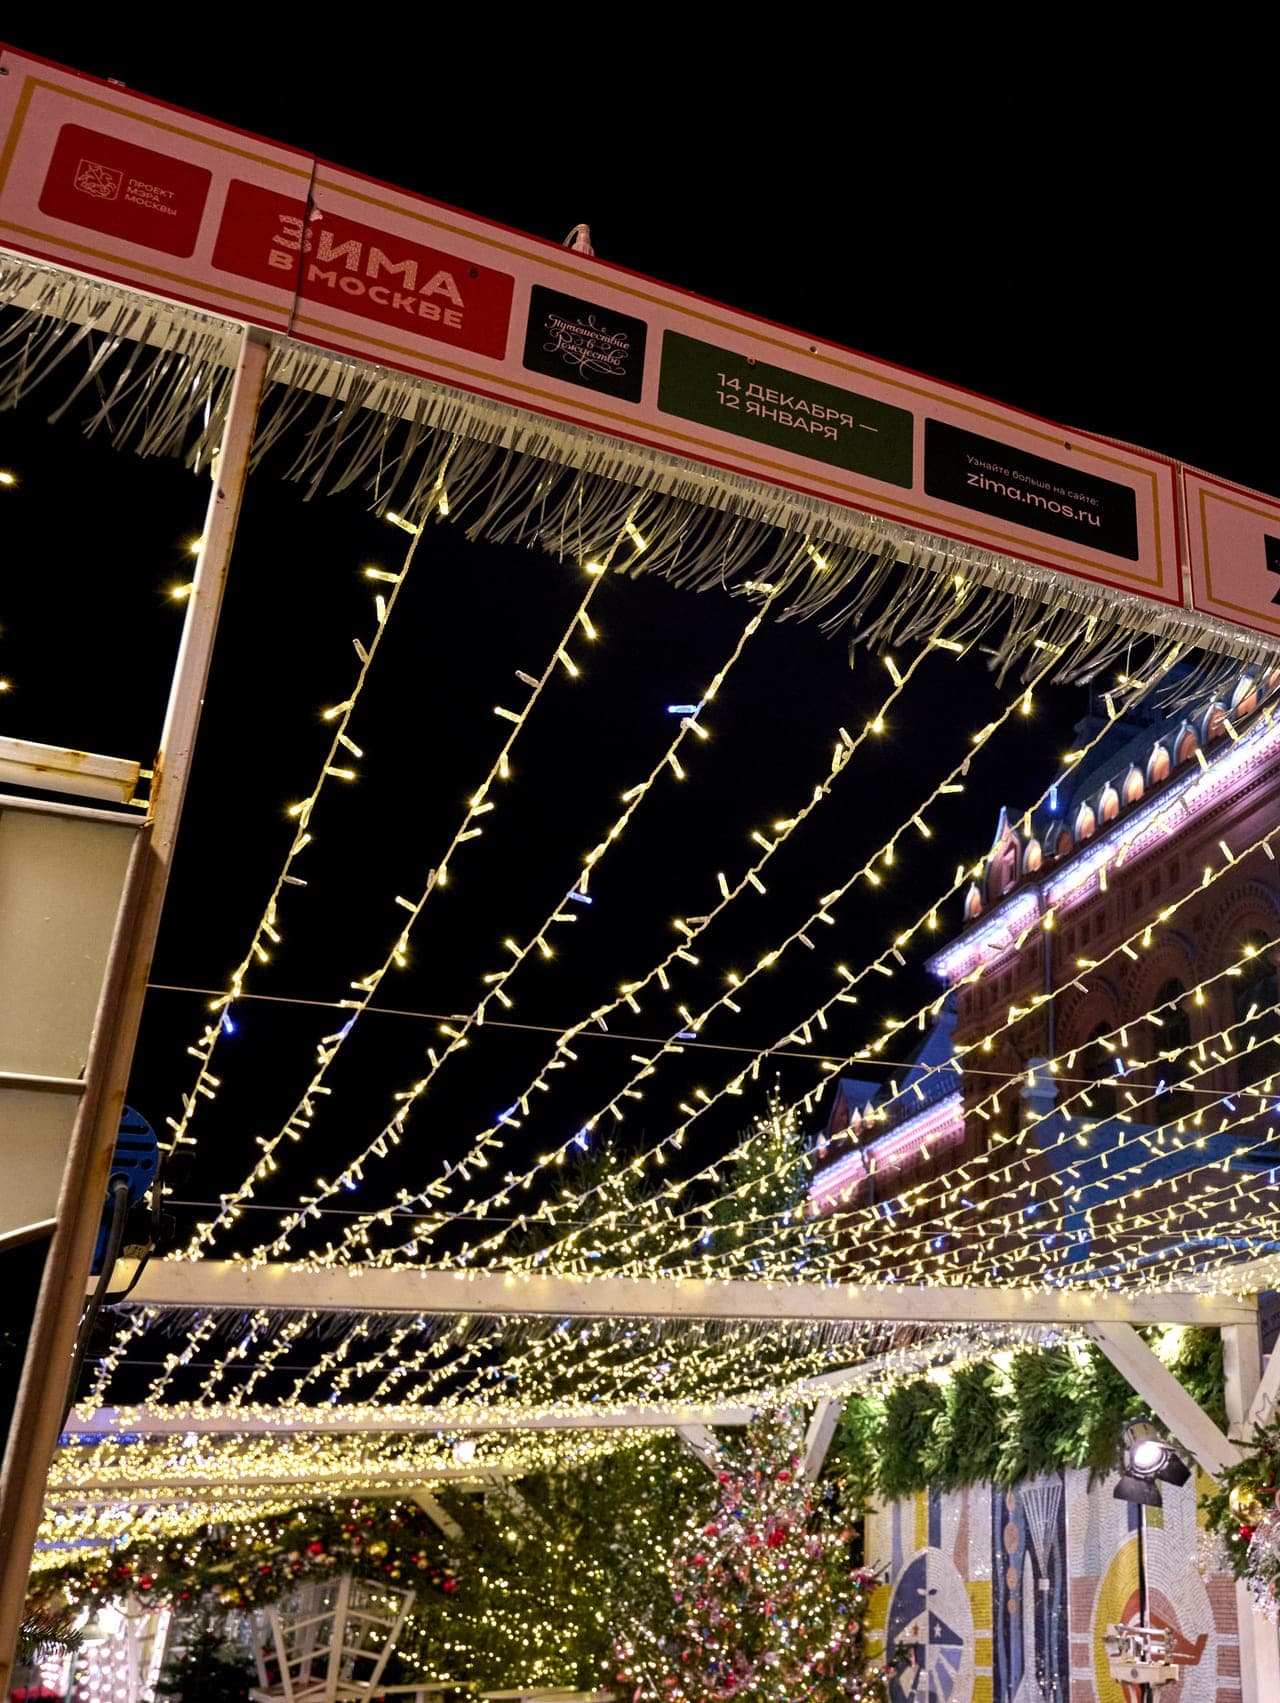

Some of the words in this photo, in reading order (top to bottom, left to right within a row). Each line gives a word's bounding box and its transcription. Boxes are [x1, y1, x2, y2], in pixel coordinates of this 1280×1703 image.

[125, 193, 177, 216] МОСКВЫ
[127, 186, 160, 202] МЭРА
[129, 178, 175, 199] ПРОЕКТ
[272, 214, 465, 308] ЗИМА
[268, 249, 295, 271] В
[307, 264, 464, 329] МОСКВЕ
[716, 390, 741, 410] 12
[745, 401, 838, 441] ЯНВАРЯ
[717, 372, 742, 391] 14
[745, 383, 854, 428] ДЕКАБРЯ
[966, 454, 1010, 477] Узнайте
[1012, 470, 1051, 491] больше
[1053, 486, 1066, 497] на
[967, 473, 1101, 527] zima.mos.ru
